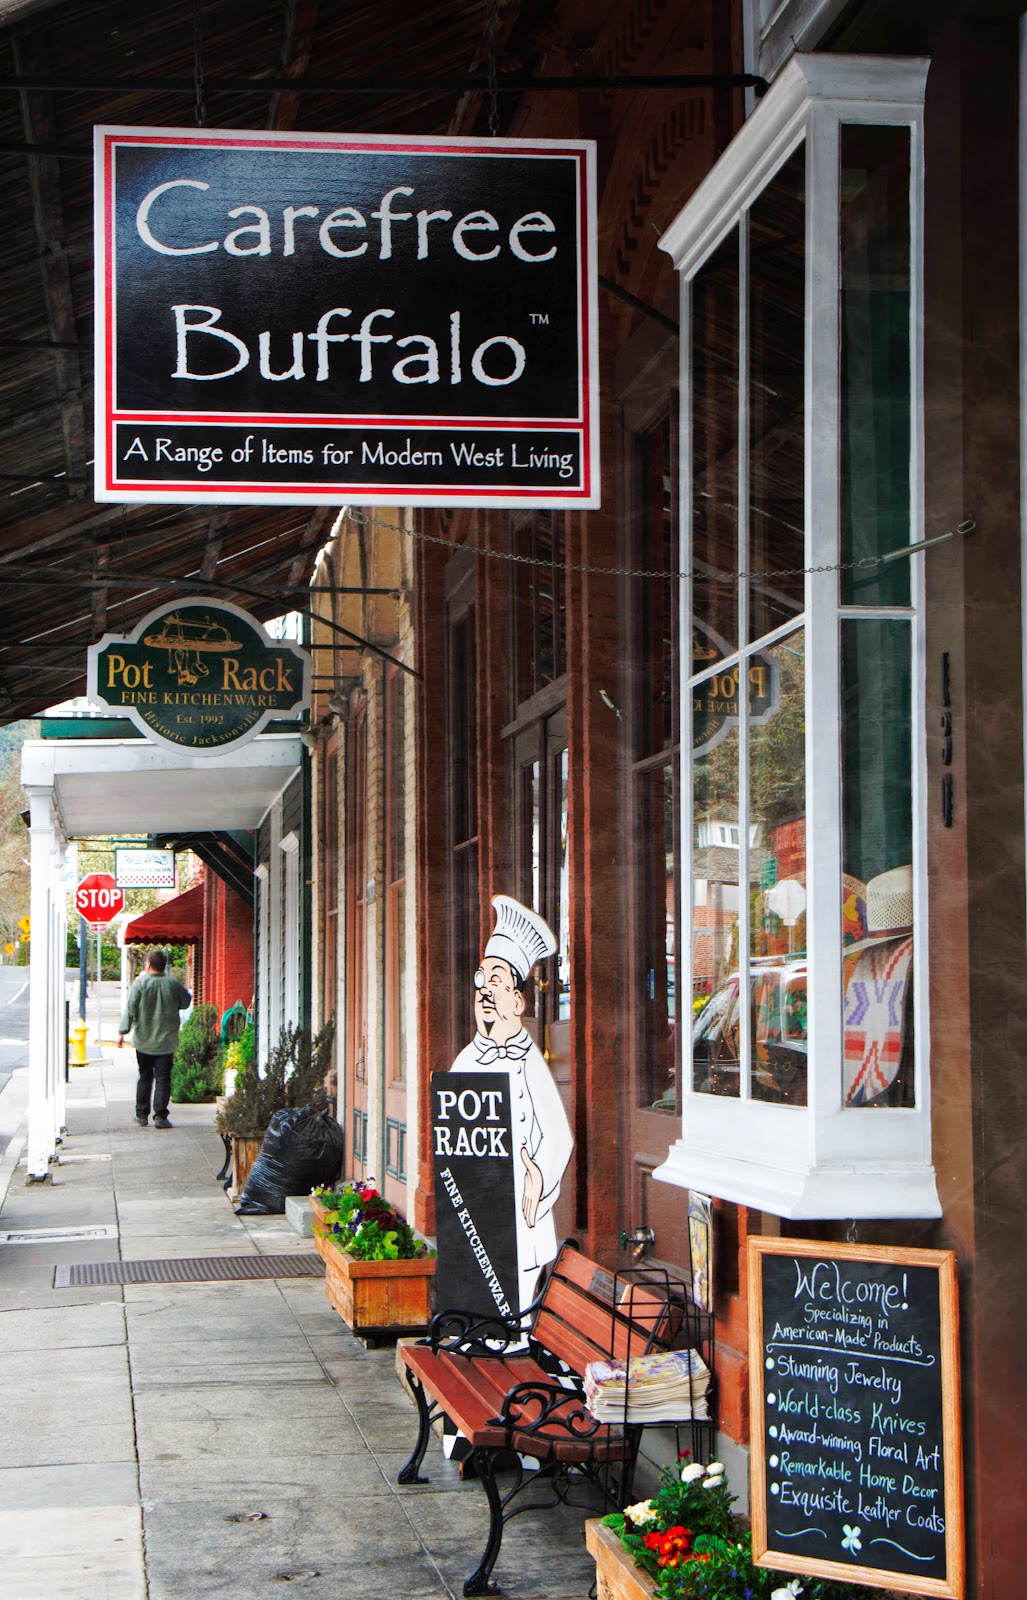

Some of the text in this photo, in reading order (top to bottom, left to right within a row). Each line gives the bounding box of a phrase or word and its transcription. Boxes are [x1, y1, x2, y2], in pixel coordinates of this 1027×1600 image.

[136, 179, 558, 262] Carefree
[170, 304, 527, 386] Buffalo
[124, 435, 574, 477] A Range of Items for Modern West Living
[106, 654, 294, 692] Pot Rack
[121, 691, 278, 708] FINE KITCHENWARE
[143, 709, 260, 746] Historic Jacksonville
[176, 714, 224, 726] Est. 1992
[77, 889, 121, 908] STOP
[437, 1090, 502, 1121] POT
[434, 1126, 509, 1157] RACK
[440, 1167, 464, 1207] FINE
[794, 1259, 909, 1316] Welcome!
[804, 1303, 889, 1338] Specializing in
[873, 1330, 924, 1357] Products
[777, 1355, 902, 1405] Stunning Jewelry
[777, 1388, 927, 1436] World-class Knives
[778, 1423, 941, 1472] Award-winning Floral Art
[780, 1451, 939, 1500] Remarkable Home Decor
[780, 1481, 946, 1534] Exquisite Leather Coats
